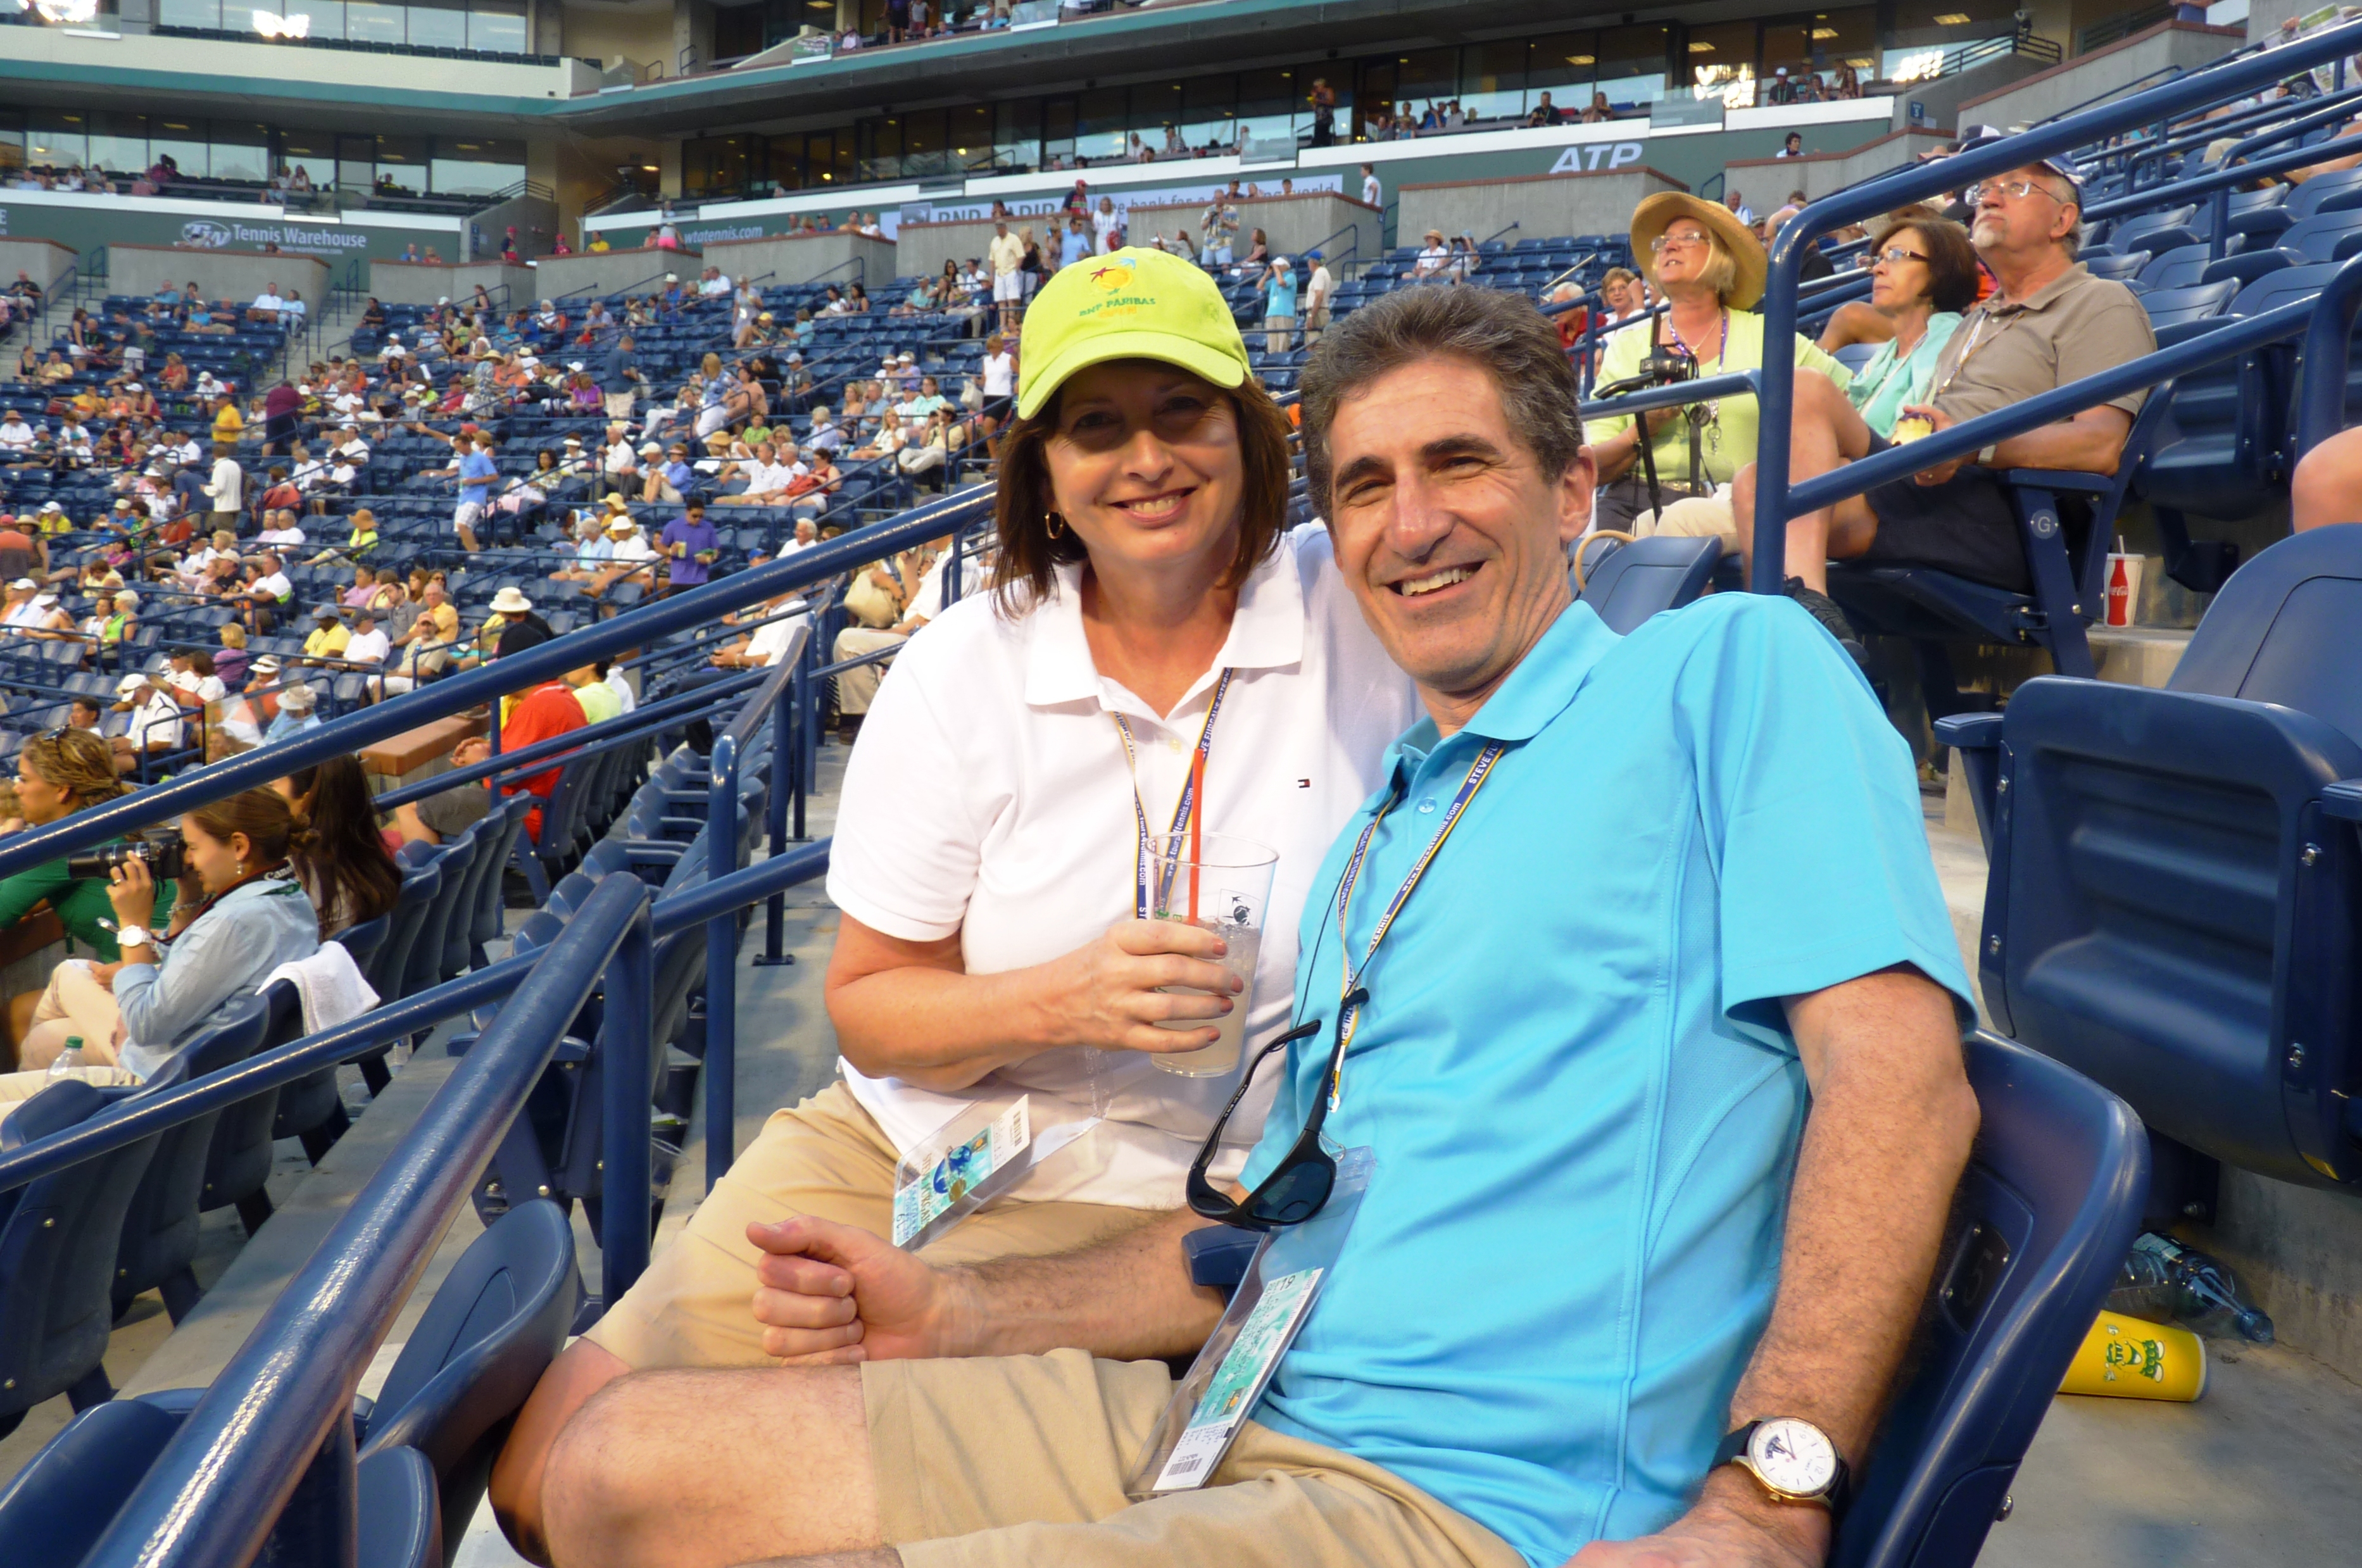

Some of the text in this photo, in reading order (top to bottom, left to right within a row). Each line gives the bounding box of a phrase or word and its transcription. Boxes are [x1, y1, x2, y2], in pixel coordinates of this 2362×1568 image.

[1549, 142, 1643, 175] ATP
[232, 223, 367, 248] Tennis Warehouse
[1106, 297, 1156, 308] PARIBAS
[2037, 516, 2051, 533] G
[1469, 756, 1492, 784] STEVE
